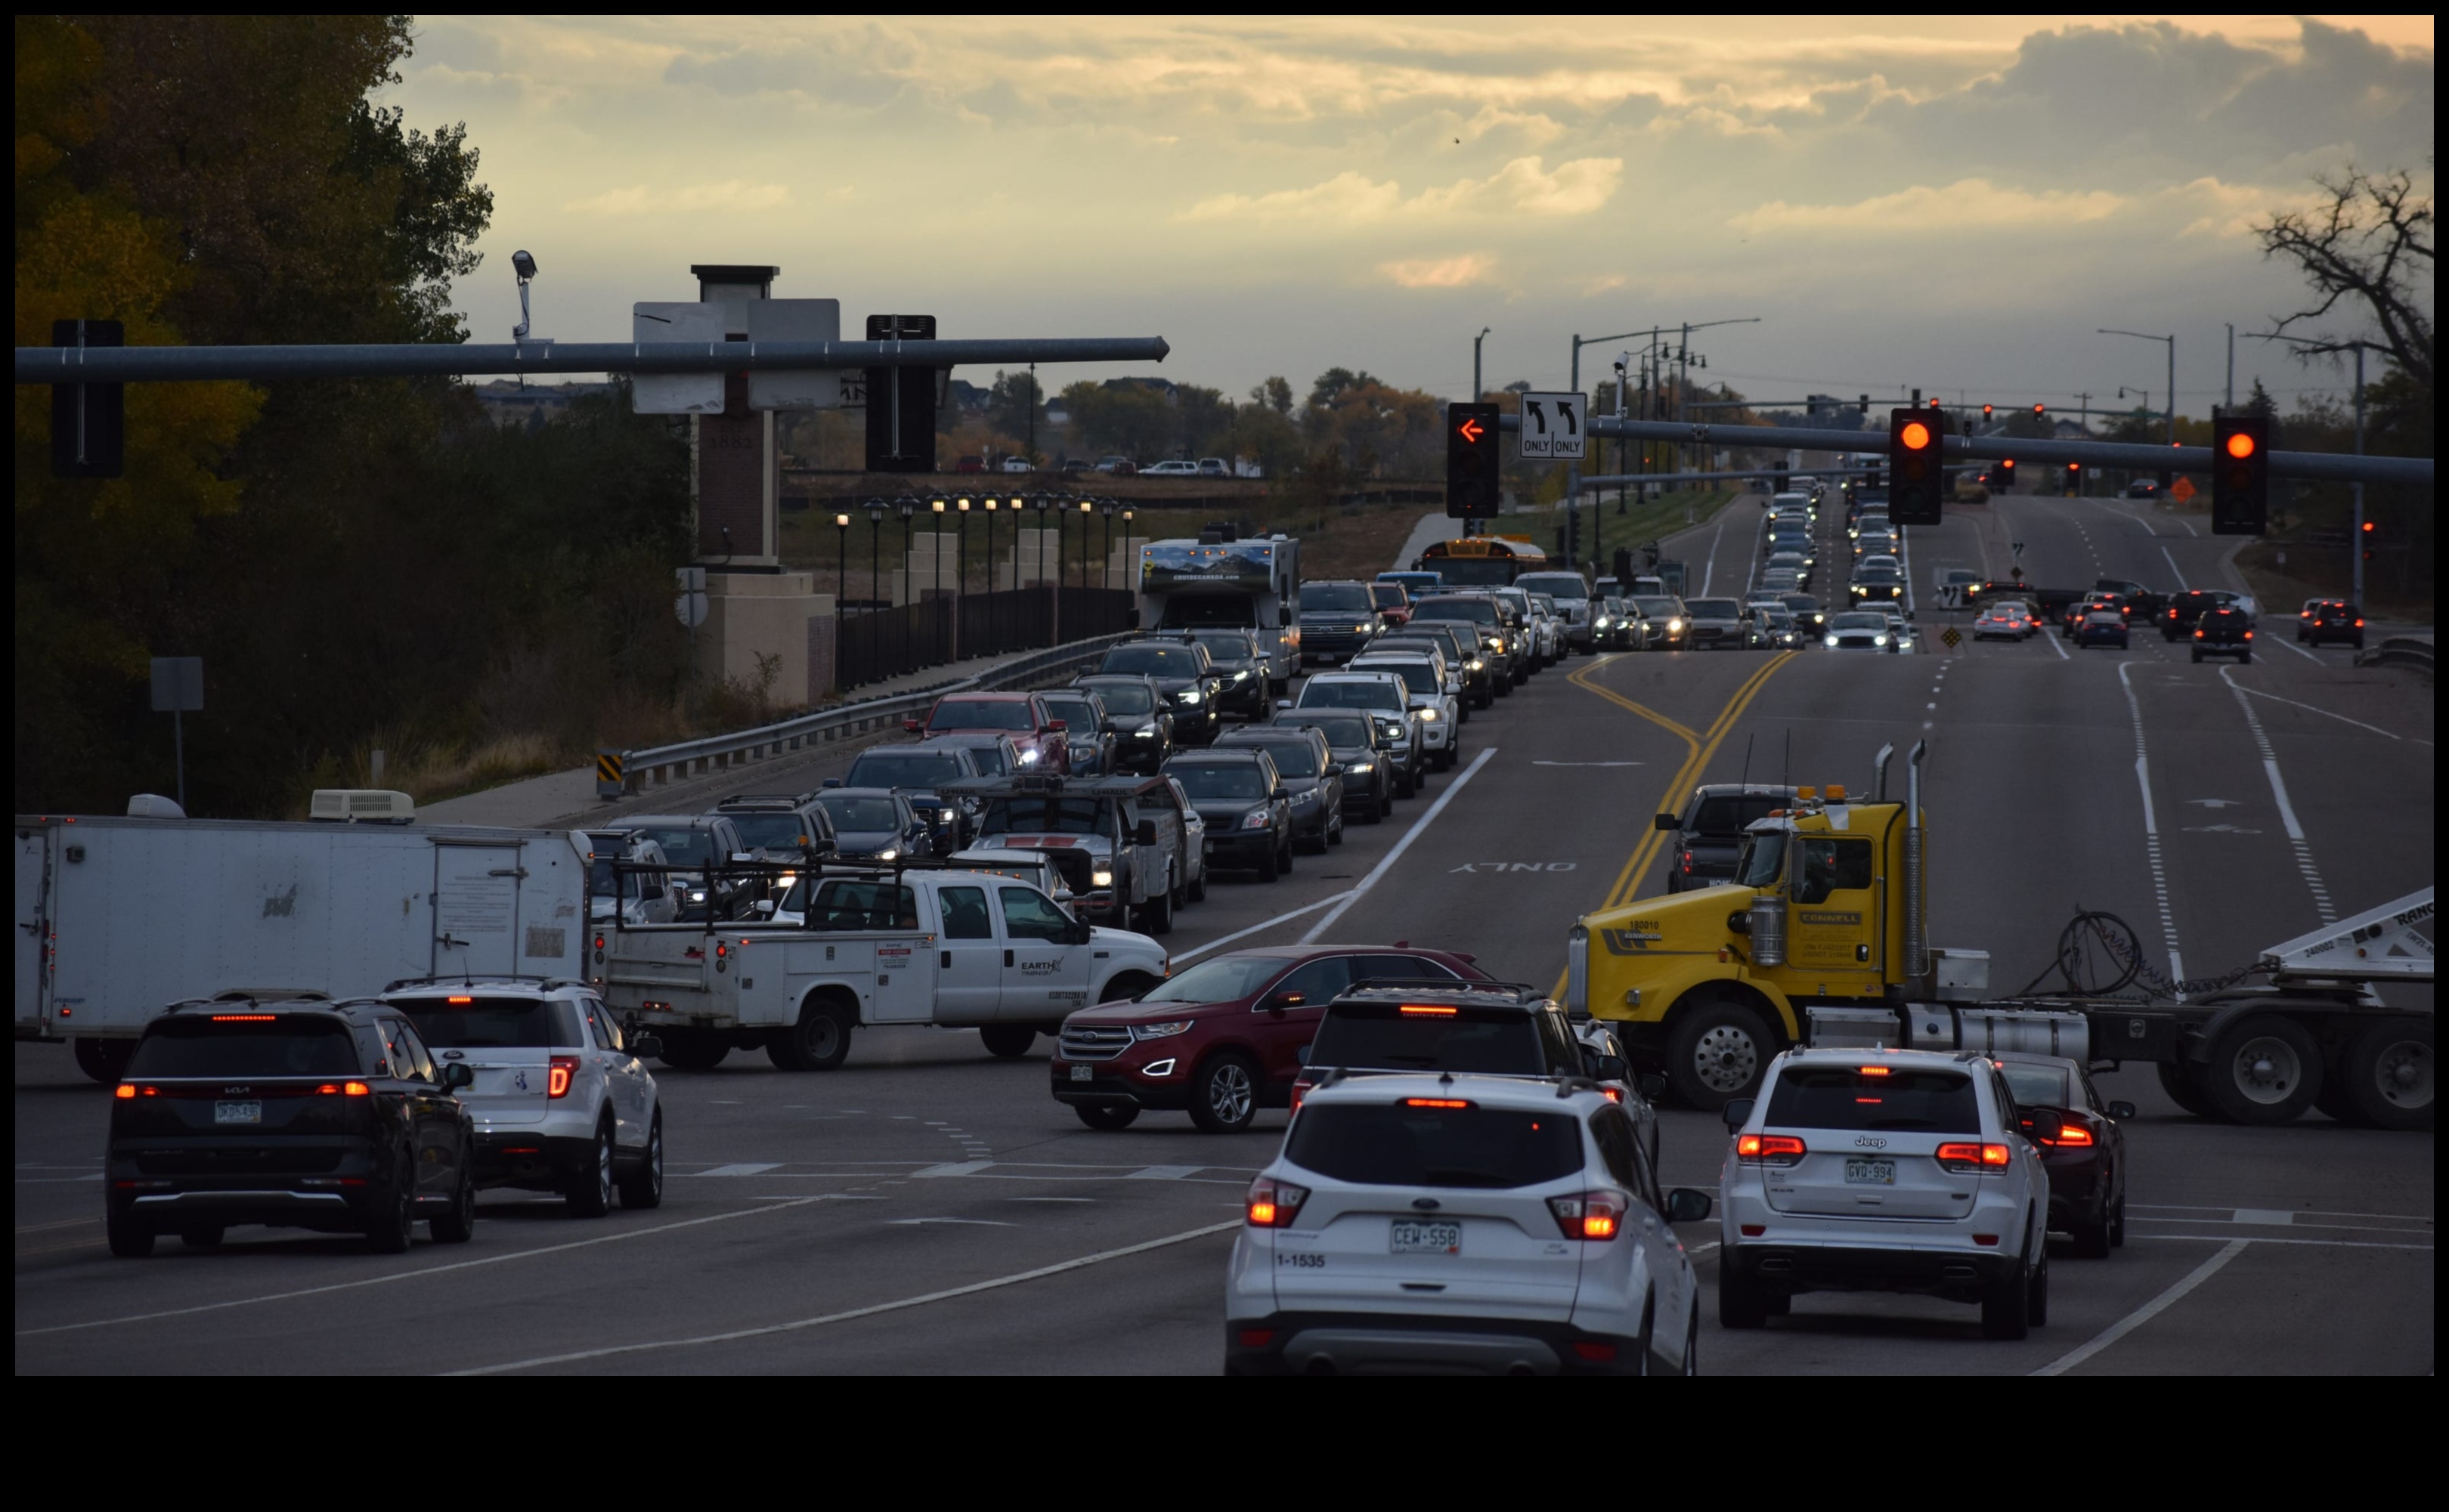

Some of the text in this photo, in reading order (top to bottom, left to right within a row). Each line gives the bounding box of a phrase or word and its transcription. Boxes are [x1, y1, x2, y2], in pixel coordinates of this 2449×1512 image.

[711, 434, 753, 448] 1882
[1525, 441, 1581, 452] ONLY ONLY
[1447, 862, 1577, 873] ONLY
[1709, 879, 1732, 888] HOM
[1630, 920, 1659, 929] 180010
[2305, 941, 2334, 957] 240002
[224, 1086, 249, 1094] KIA
[1855, 1135, 1887, 1149] Jeep
[1277, 1254, 1325, 1268] 1-1535
